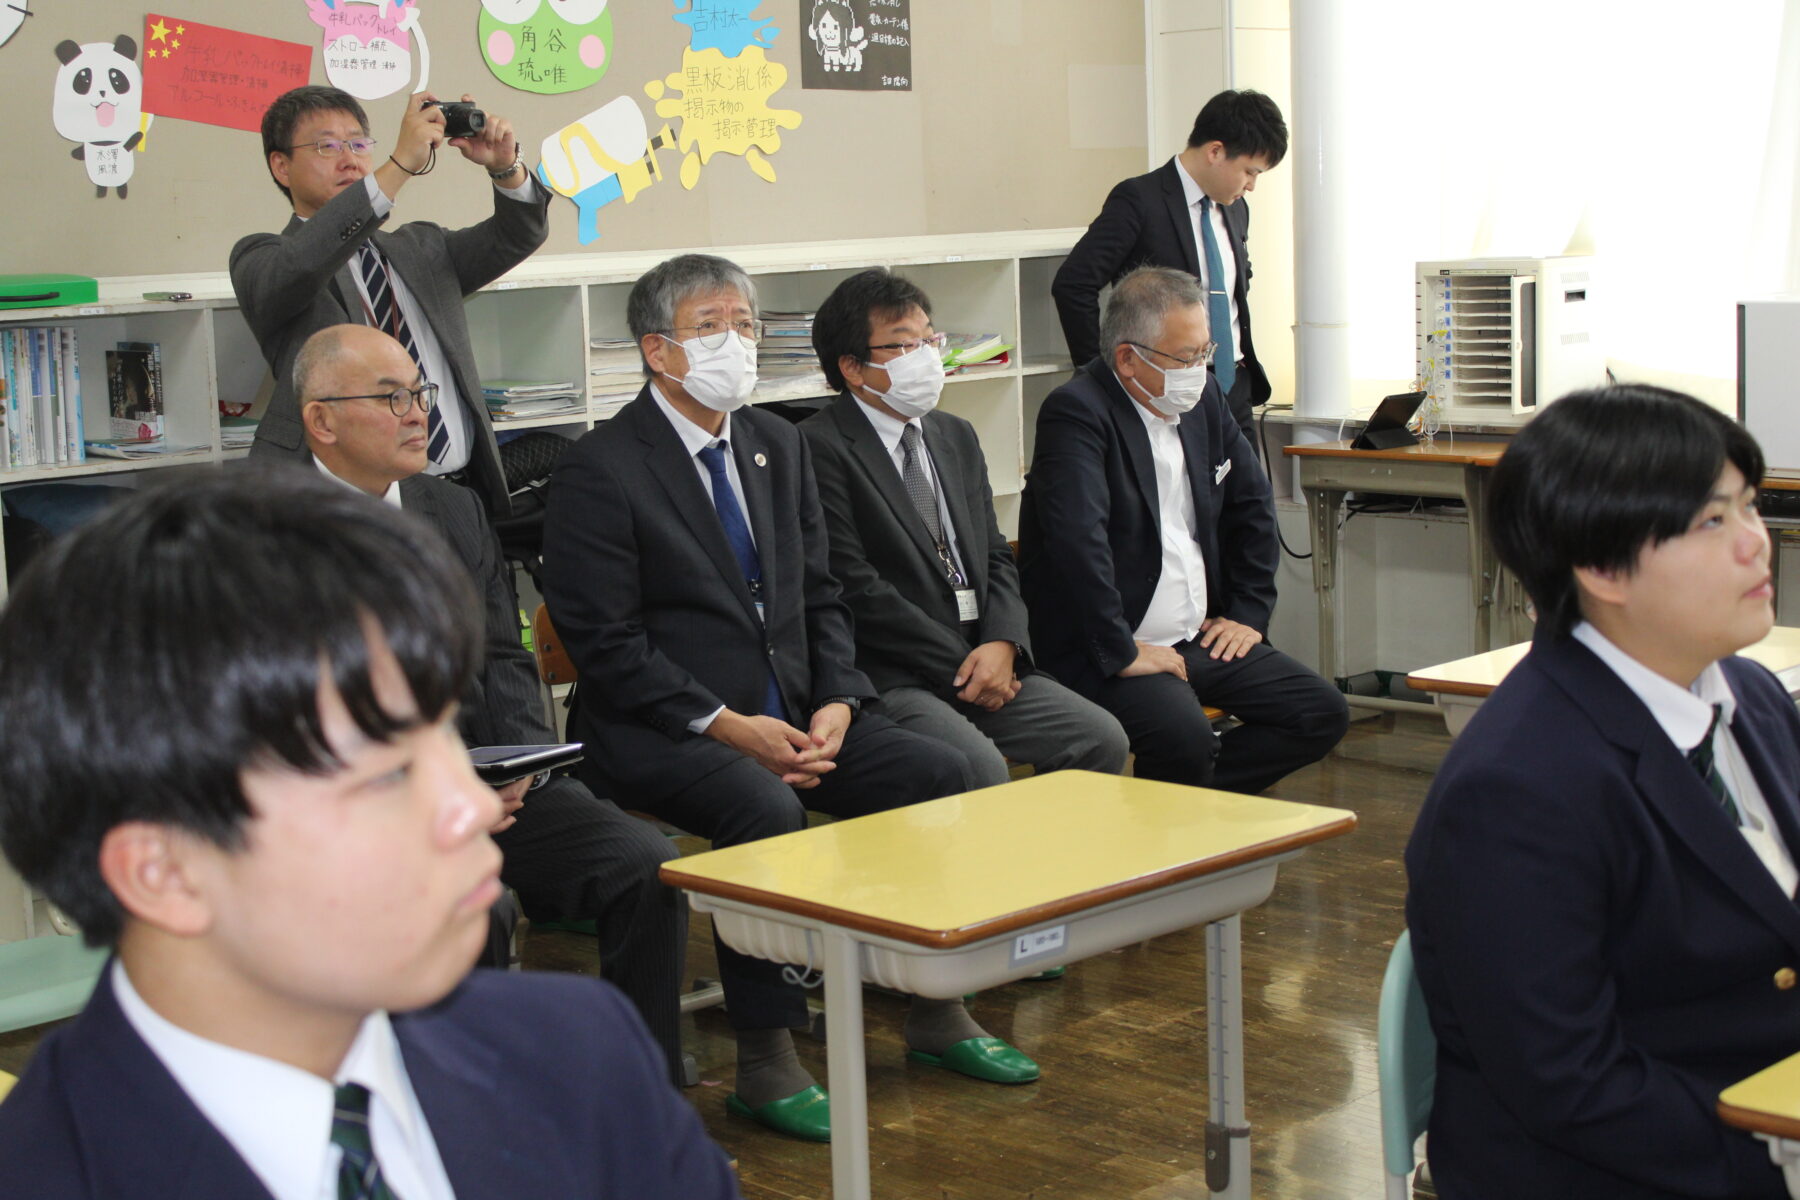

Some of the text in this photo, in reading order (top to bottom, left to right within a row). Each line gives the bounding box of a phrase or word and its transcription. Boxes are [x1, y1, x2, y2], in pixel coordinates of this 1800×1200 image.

[328, 11, 379, 28] 牛乳パック
[693, 2, 749, 33] 吉村太一
[520, 25, 567, 53] 角谷
[518, 57, 567, 85] 琉唯
[686, 64, 773, 94] 黒板消し係
[683, 97, 744, 120] 掲示物の
